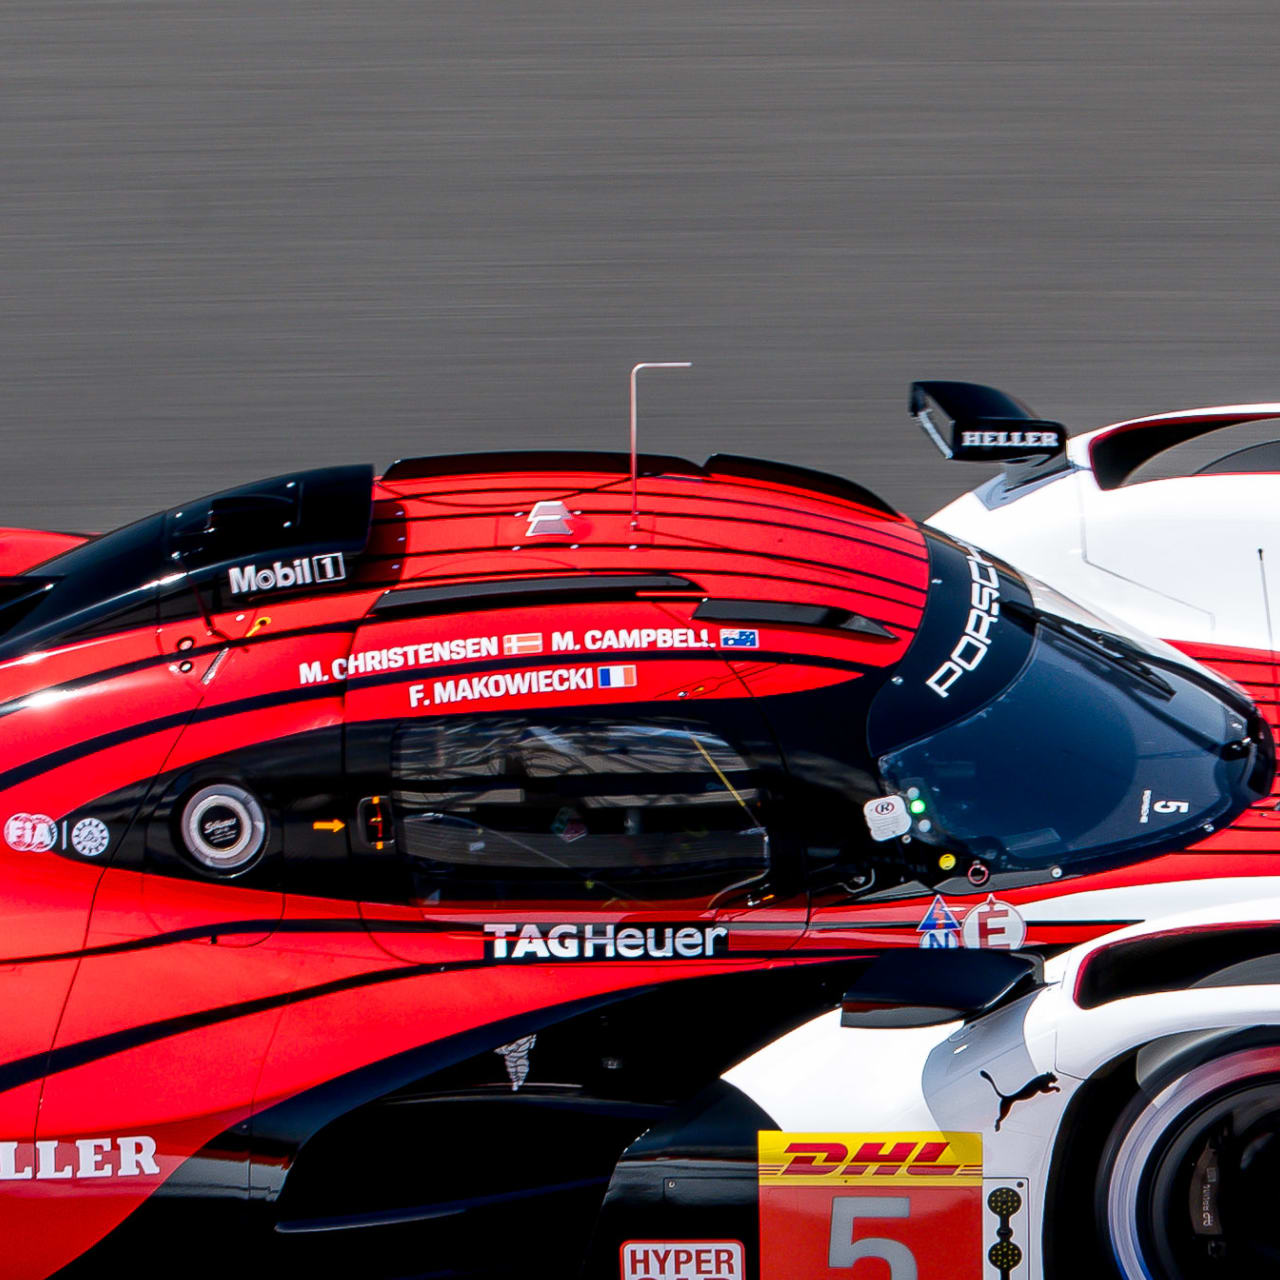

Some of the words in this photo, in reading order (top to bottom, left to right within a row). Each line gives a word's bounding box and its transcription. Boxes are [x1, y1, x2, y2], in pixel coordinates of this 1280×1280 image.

[961, 432, 1059, 447] HELLER
[228, 558, 313, 594] Mobil
[299, 662, 329, 684] M.
[332, 636, 498, 680] CHRISTENSEN
[552, 631, 580, 651] M.
[584, 628, 715, 650] CAMPBELL
[409, 685, 430, 707] F.
[435, 668, 593, 704] MAKOWIECKI
[1153, 800, 1190, 814] 5
[780, 1142, 961, 1176] DHL
[629, 1248, 735, 1276] HYPER
